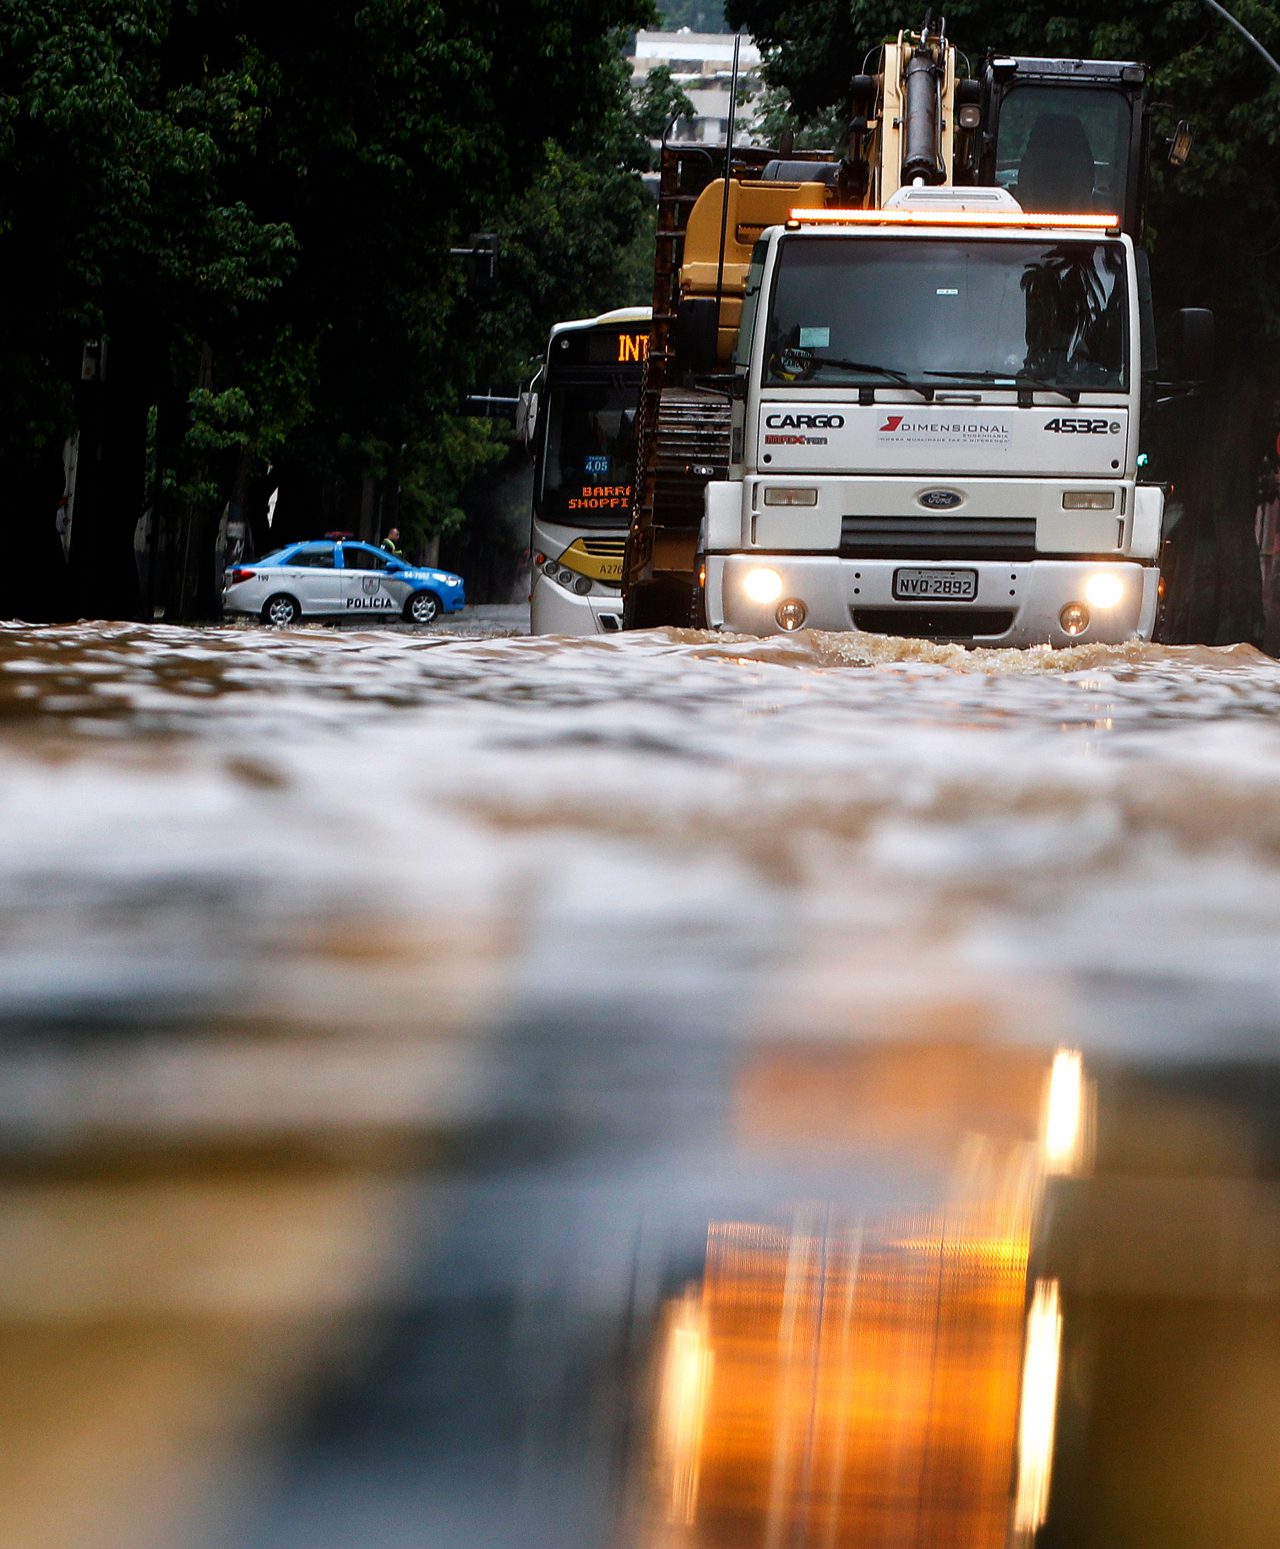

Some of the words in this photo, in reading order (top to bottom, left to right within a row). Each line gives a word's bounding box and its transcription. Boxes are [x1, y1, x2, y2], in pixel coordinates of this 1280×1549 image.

[618, 335, 650, 362] INT
[765, 414, 845, 429] CARGO
[901, 423, 1009, 433] DIMENSIONAL
[1043, 418, 1121, 434] 4532e
[568, 498, 629, 508] SHOPPI
[928, 492, 953, 505] Ford
[346, 596, 393, 609] POLÍCIA
